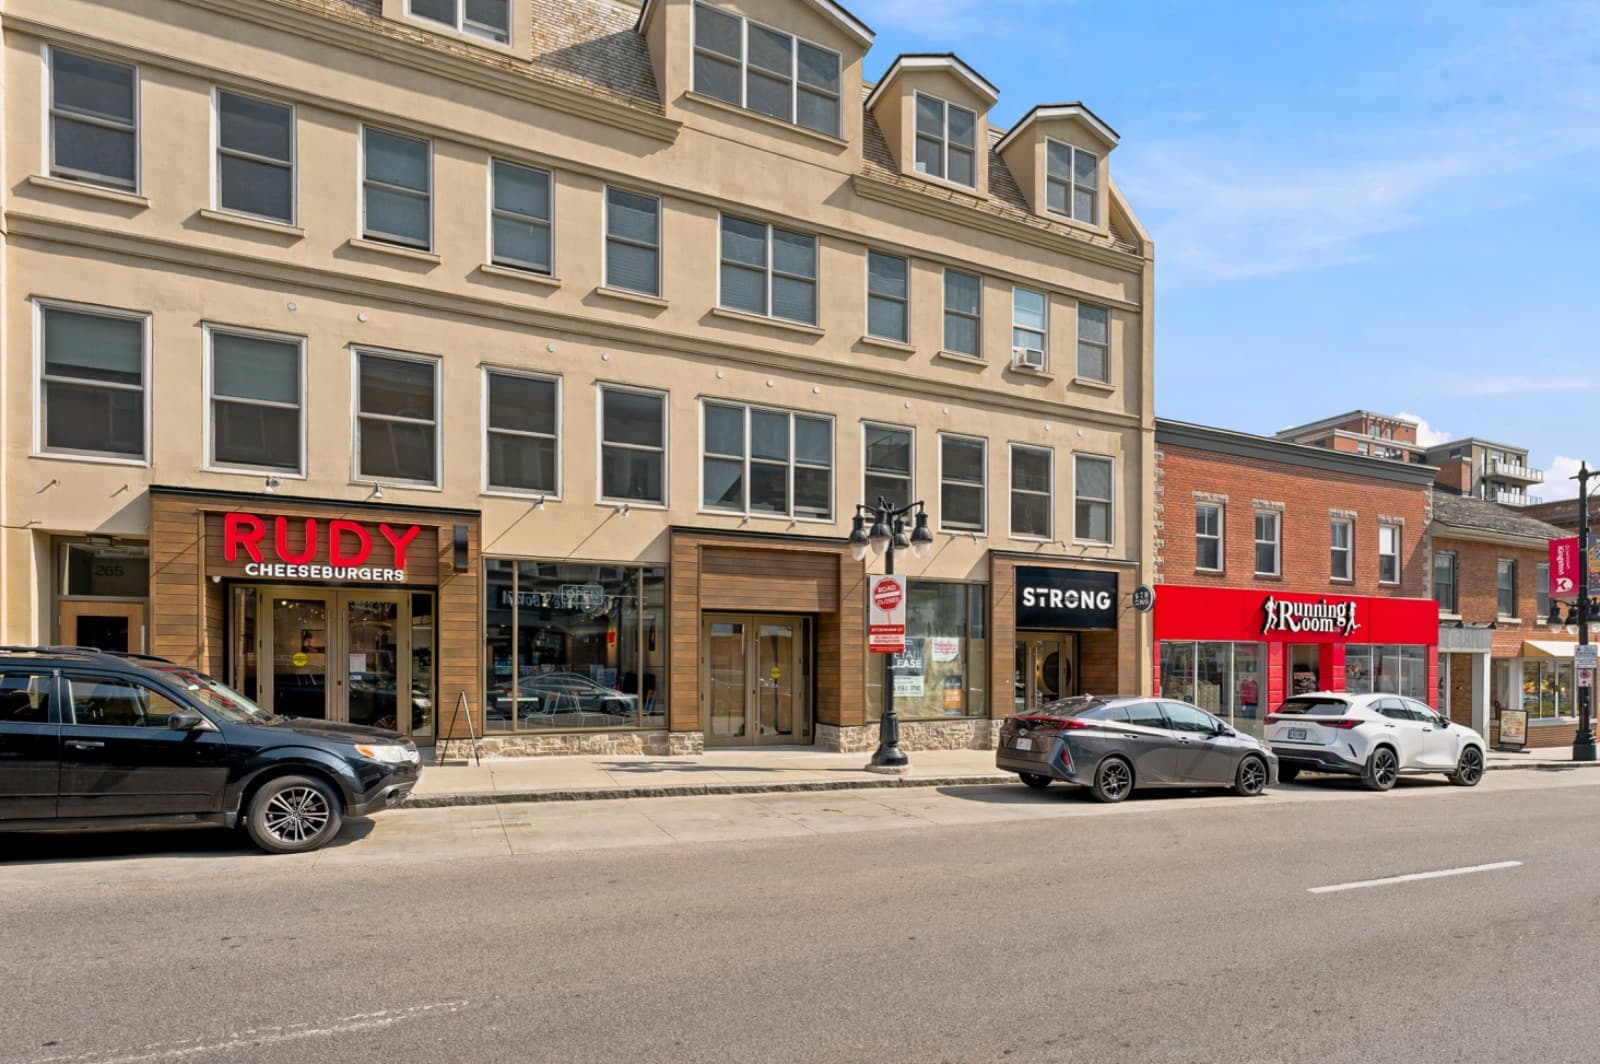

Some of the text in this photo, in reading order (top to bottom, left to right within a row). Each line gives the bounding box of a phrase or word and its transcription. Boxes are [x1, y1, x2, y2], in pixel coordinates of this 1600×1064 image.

[224, 512, 421, 570] RUDY
[245, 562, 404, 581] CHEESEBURGERS
[878, 584, 897, 593] ROAD
[1023, 587, 1111, 610] STRONG
[1277, 600, 1346, 630] Running
